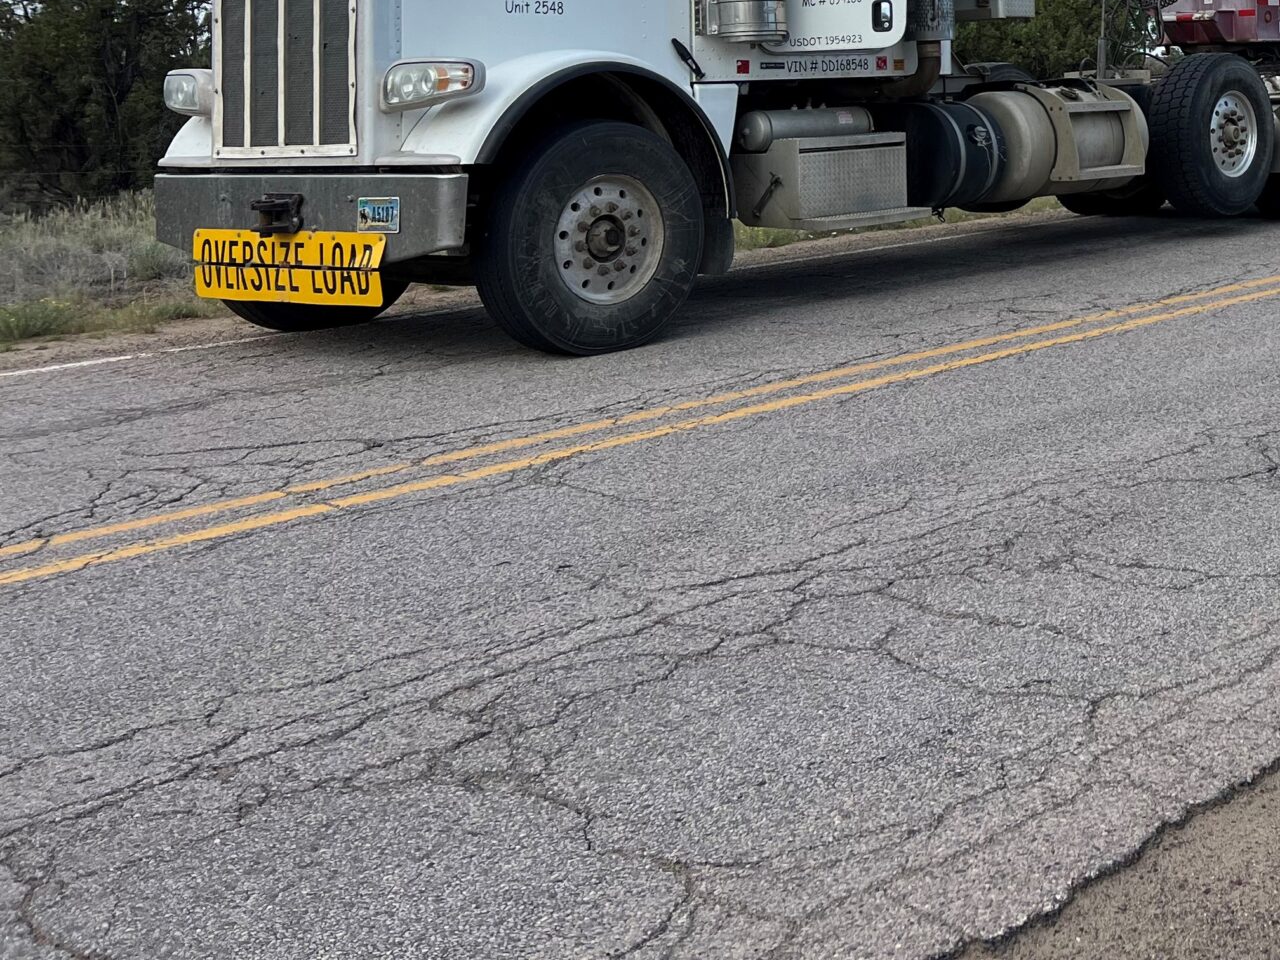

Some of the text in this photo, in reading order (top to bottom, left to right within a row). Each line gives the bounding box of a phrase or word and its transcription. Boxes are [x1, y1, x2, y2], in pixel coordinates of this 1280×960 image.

[505, 0, 564, 15] Unit 2548
[789, 34, 863, 47] USDOT 1954923
[786, 60, 807, 73] VIN
[810, 60, 819, 72] #
[821, 58, 869, 72] DD168548
[201, 238, 373, 296] OVERSIZE LOAD
